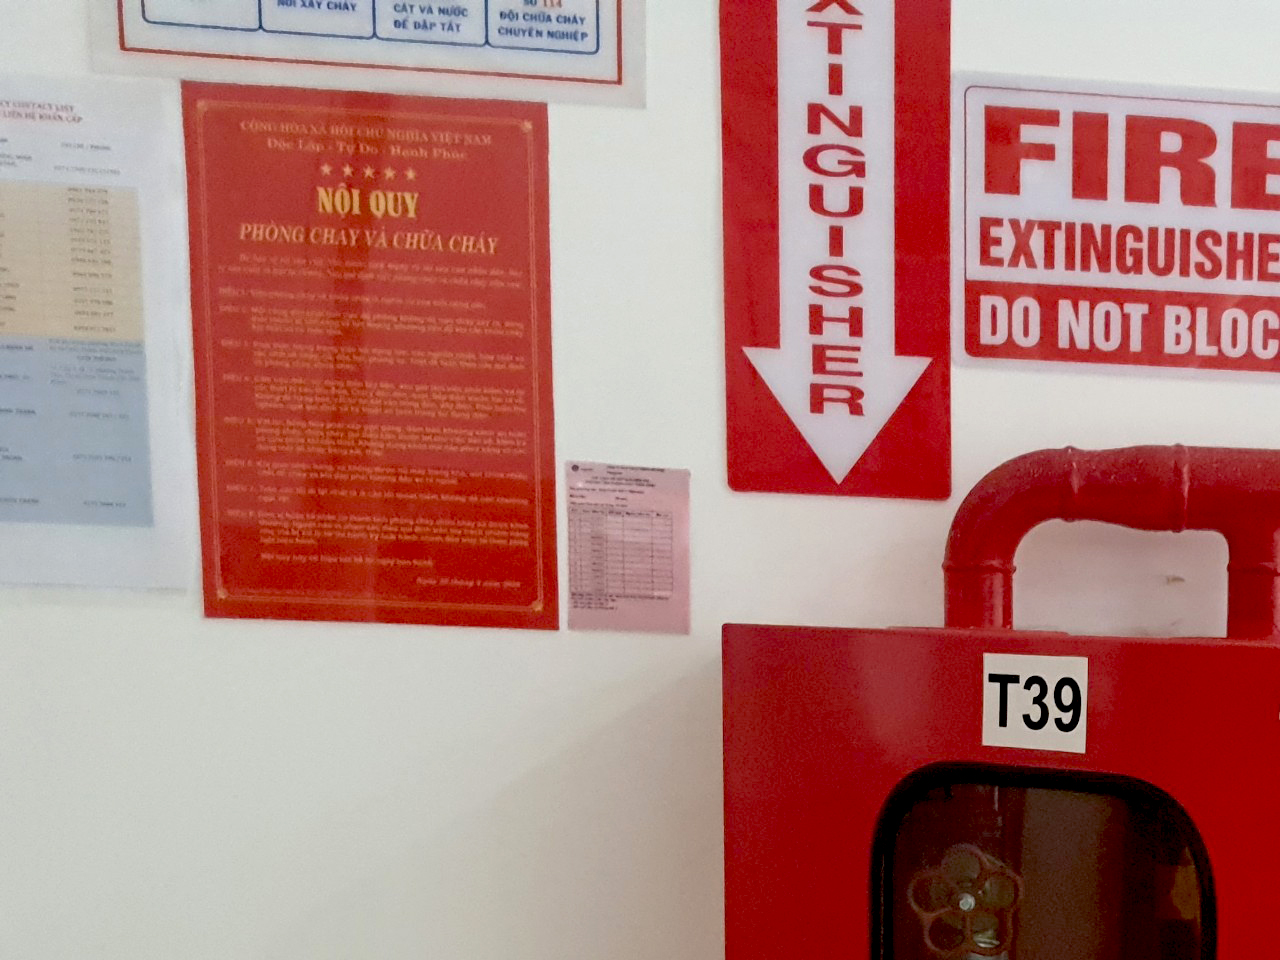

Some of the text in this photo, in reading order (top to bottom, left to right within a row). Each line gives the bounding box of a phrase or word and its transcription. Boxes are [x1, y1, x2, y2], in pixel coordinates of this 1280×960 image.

[316, 182, 419, 219] NỘI QUY
[979, 295, 1041, 347] DO
[1057, 299, 1148, 355] NOT
[987, 672, 1082, 733] T39
